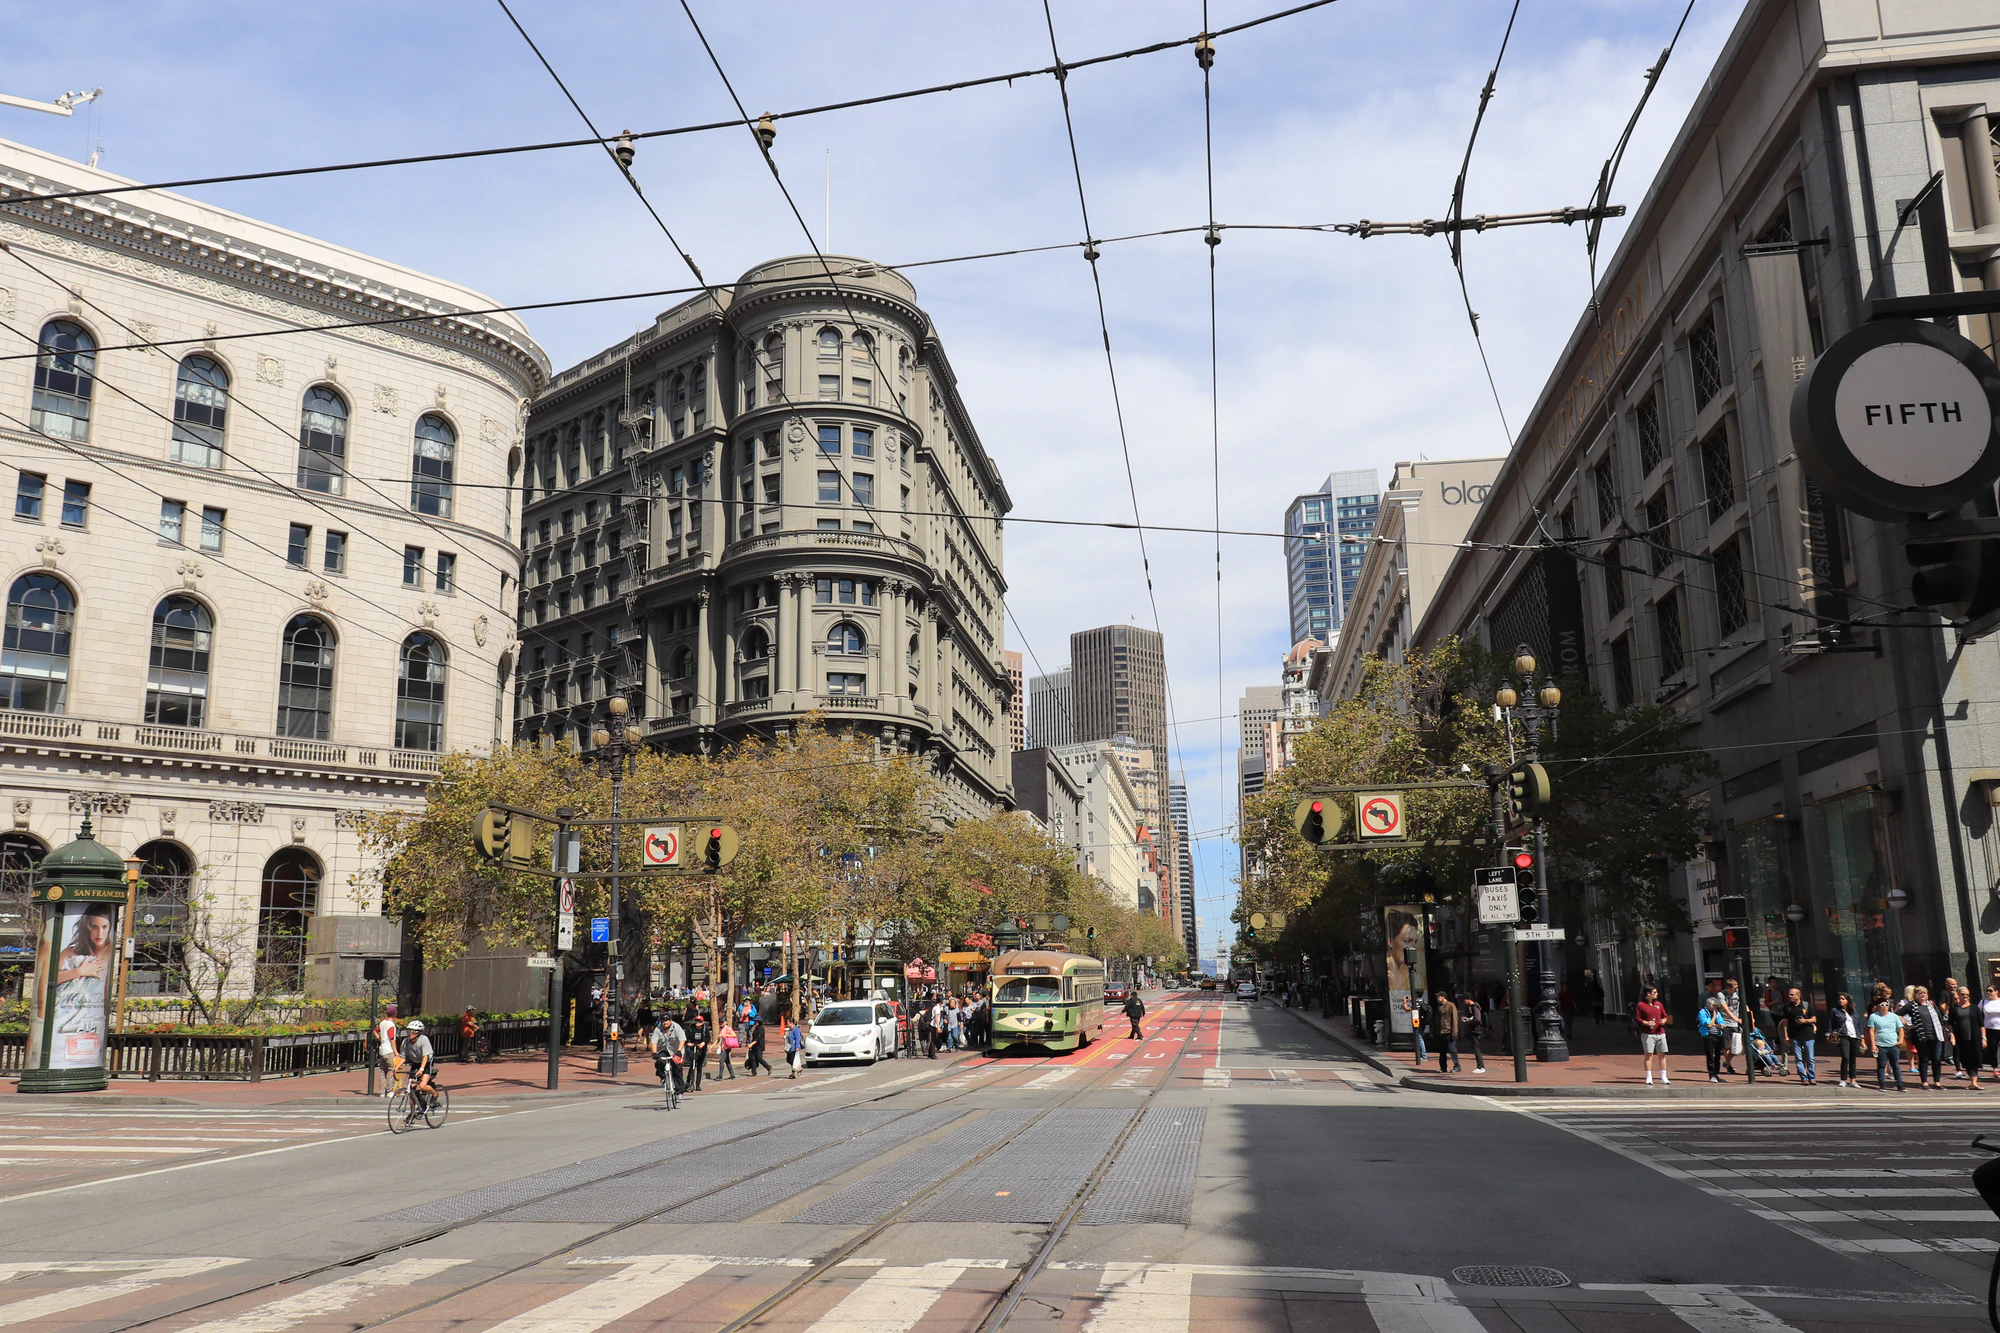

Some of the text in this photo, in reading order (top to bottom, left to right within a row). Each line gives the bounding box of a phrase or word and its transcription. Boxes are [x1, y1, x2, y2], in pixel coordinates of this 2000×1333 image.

[1547, 273, 1646, 469] NORDSTROM
[1864, 401, 1962, 426] FIFTH
[1797, 507, 1834, 604] Westfield
[1558, 630, 1579, 674] ROM
[1075, 745, 1097, 754] BUILDING
[1485, 886, 1509, 894] BUSES
